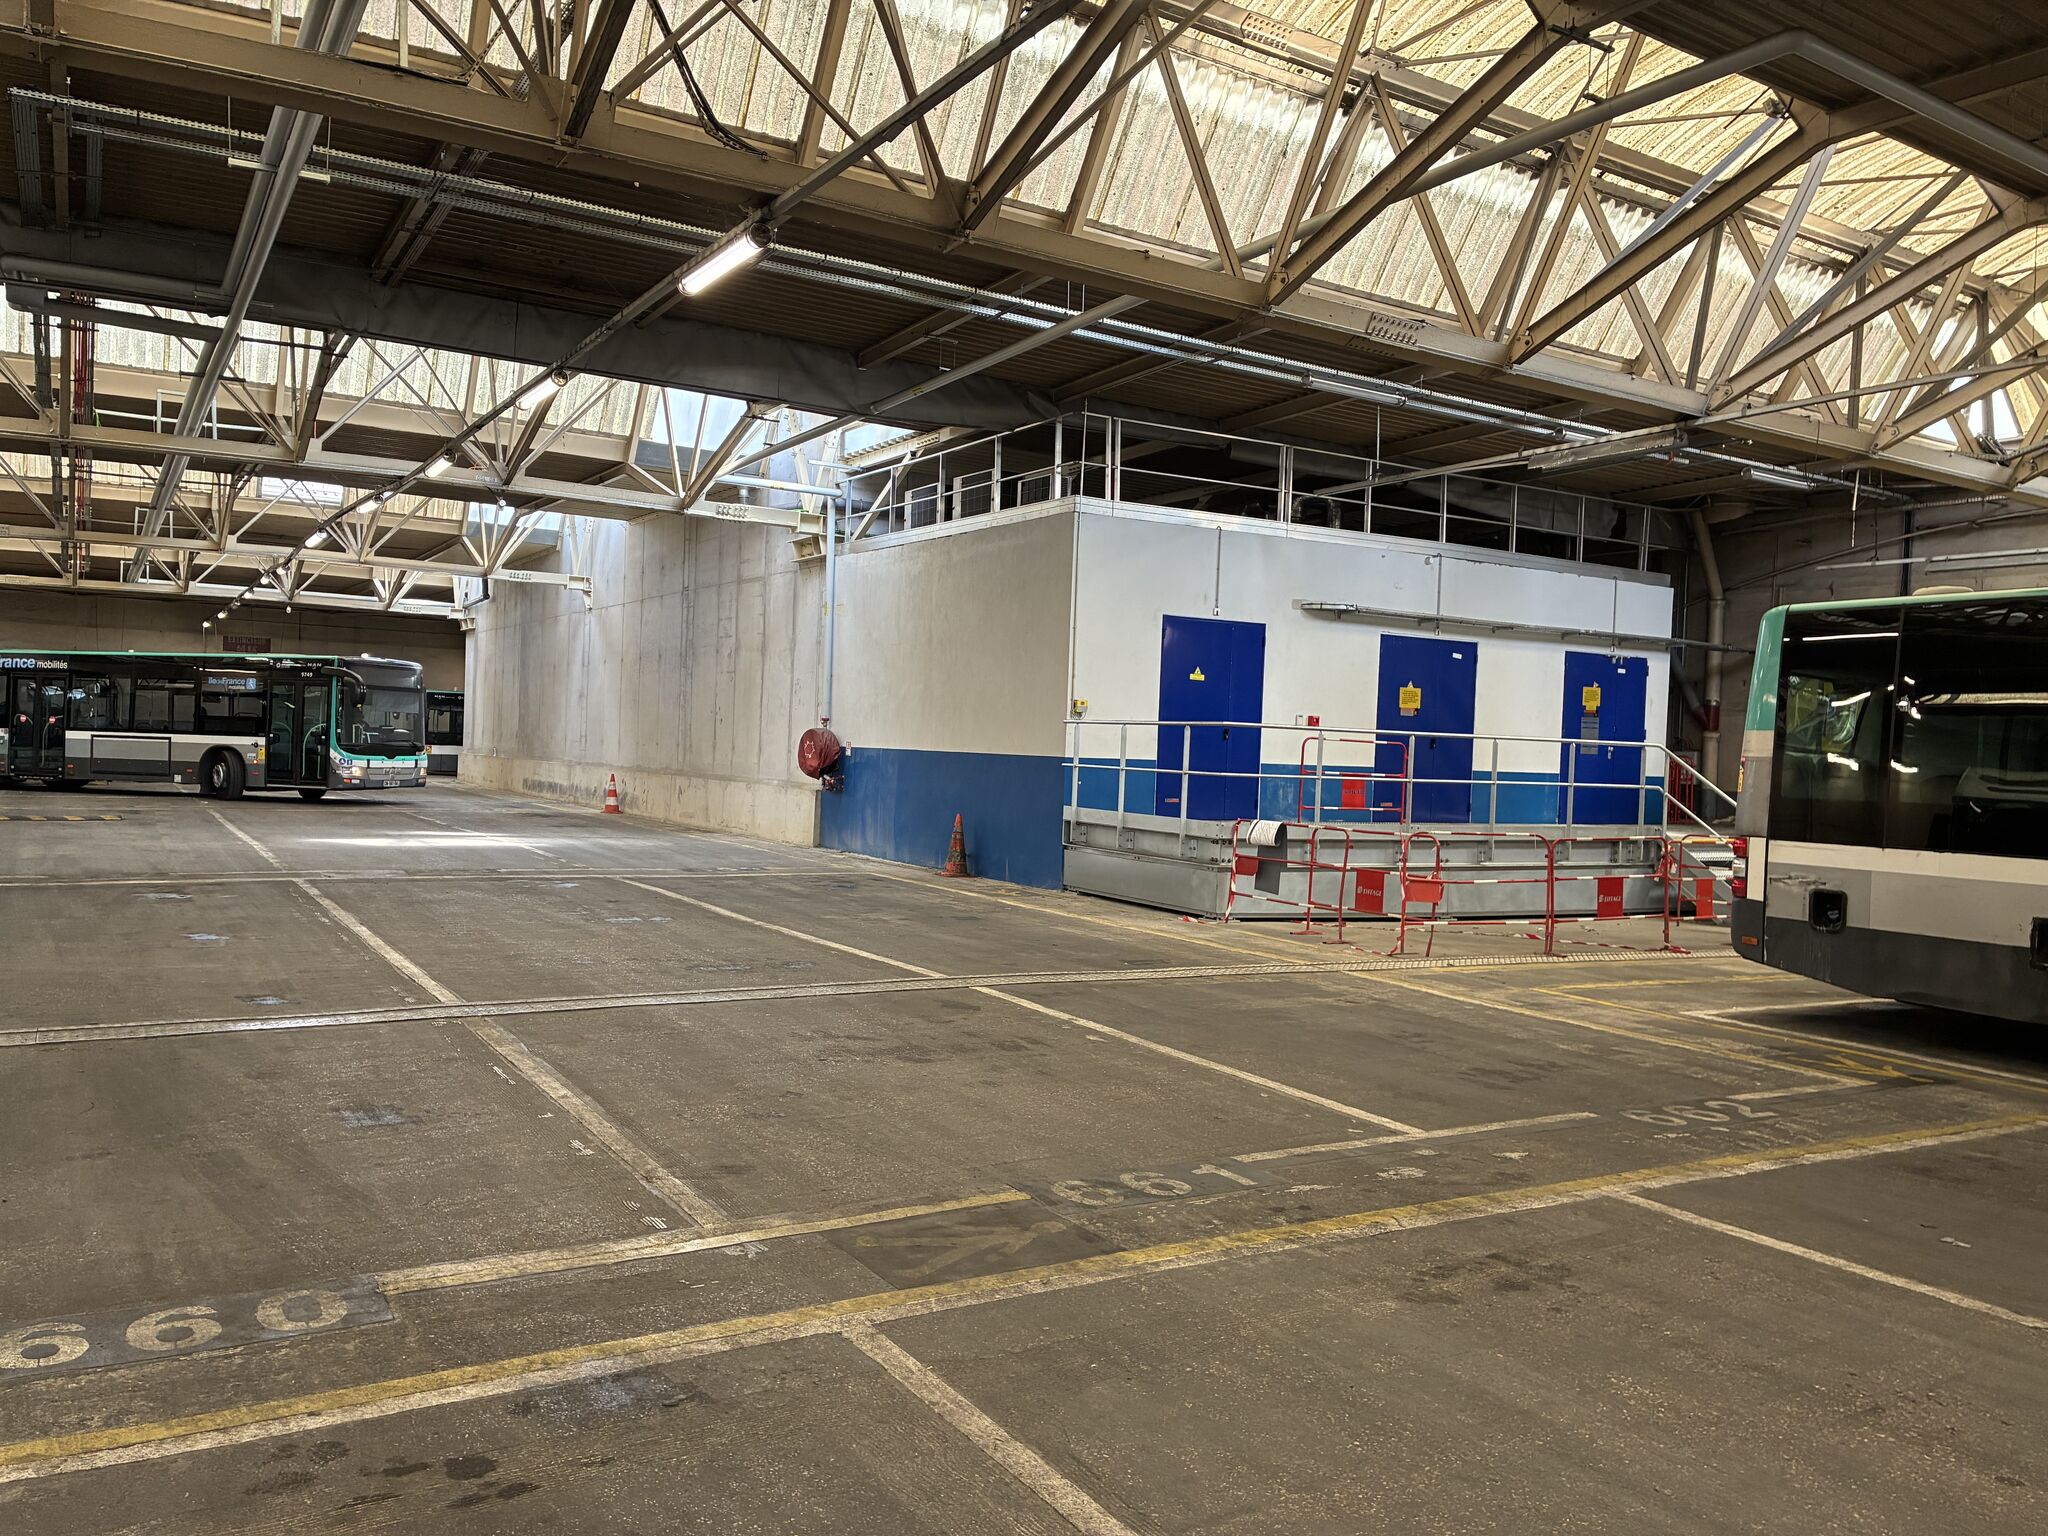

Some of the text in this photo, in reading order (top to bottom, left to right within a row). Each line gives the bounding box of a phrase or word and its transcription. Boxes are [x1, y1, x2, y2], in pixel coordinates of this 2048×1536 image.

[36, 660, 68, 669] mobilités
[1618, 1100, 1779, 1126] 662
[1051, 1163, 1258, 1206] 661
[0, 1289, 348, 1369] 660
